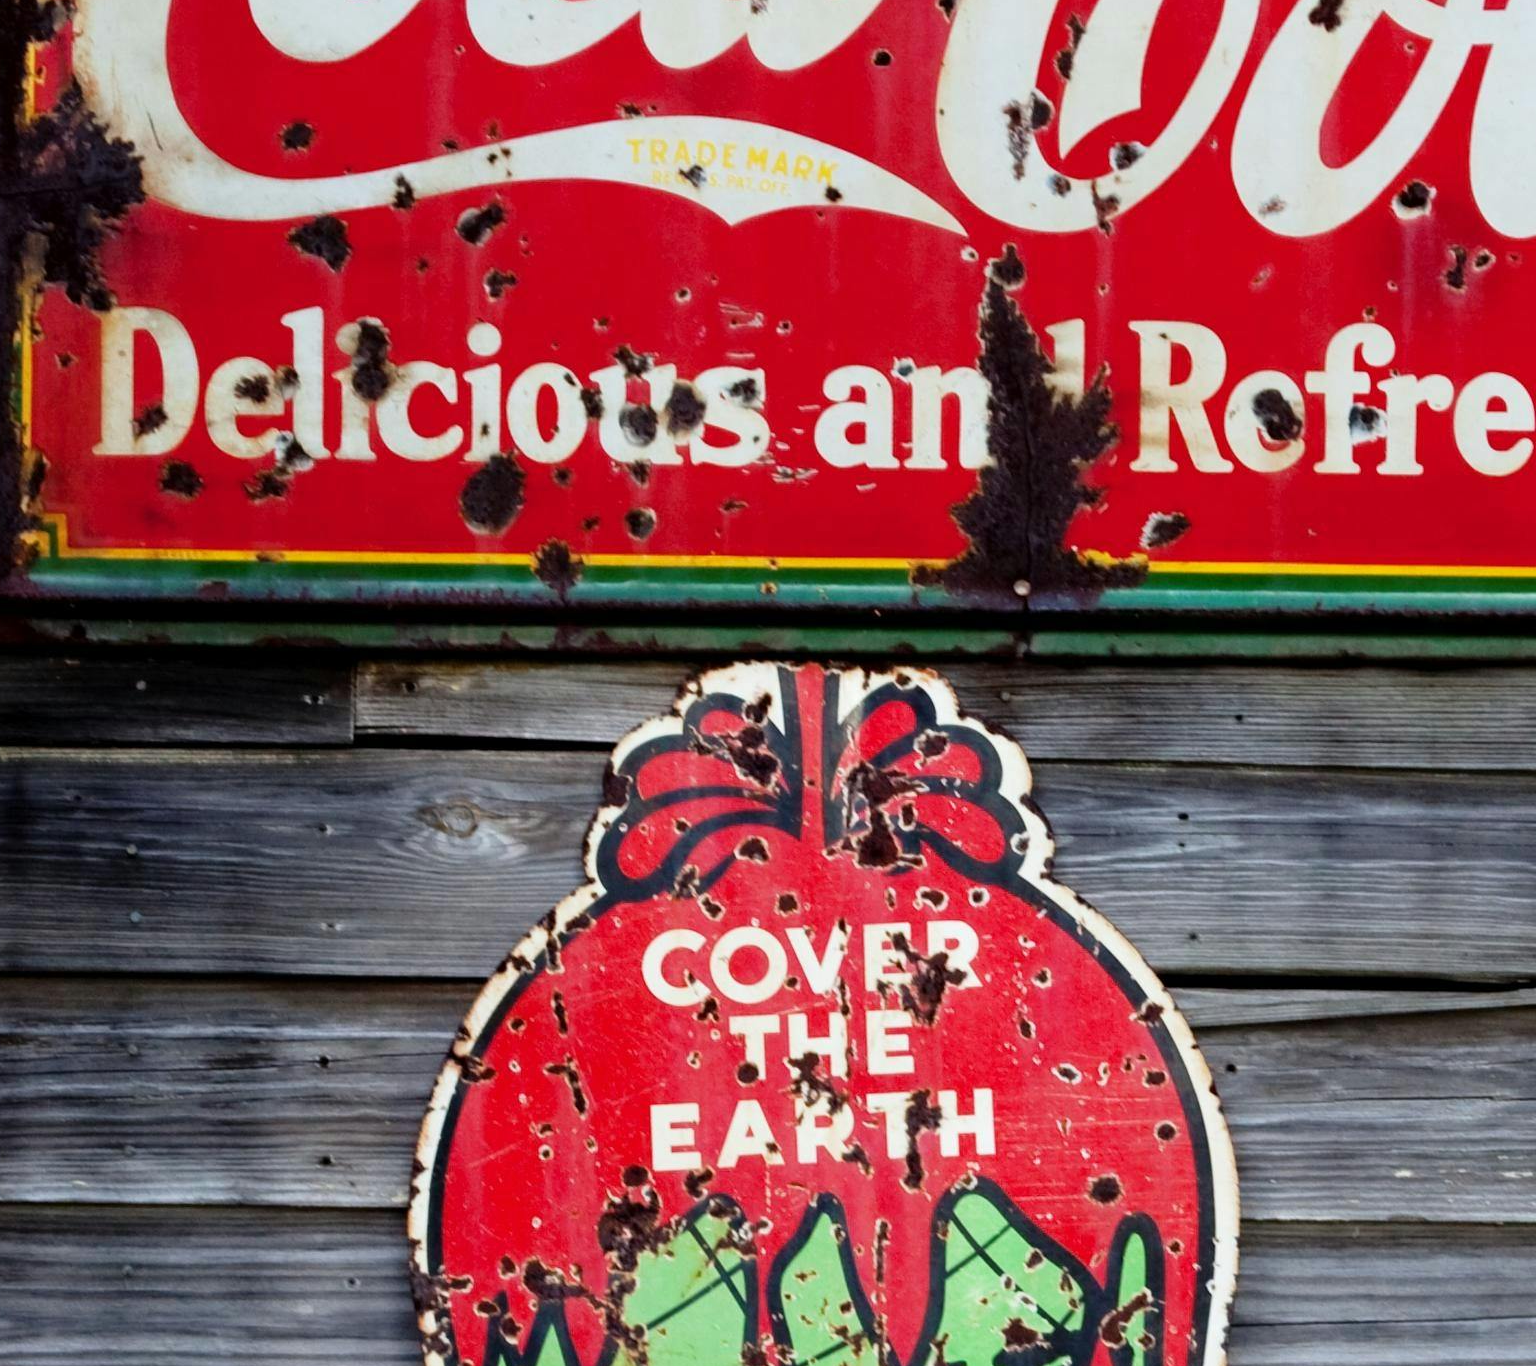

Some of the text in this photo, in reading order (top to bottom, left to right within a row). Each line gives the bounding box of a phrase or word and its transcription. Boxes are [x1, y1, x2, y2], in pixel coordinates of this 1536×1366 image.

[625, 138, 840, 185] TRADE MARK
[92, 305, 768, 469] Delicious
[641, 920, 982, 1008] COVER
[729, 1009, 916, 1086] THE
[649, 1087, 998, 1172] EARTH
